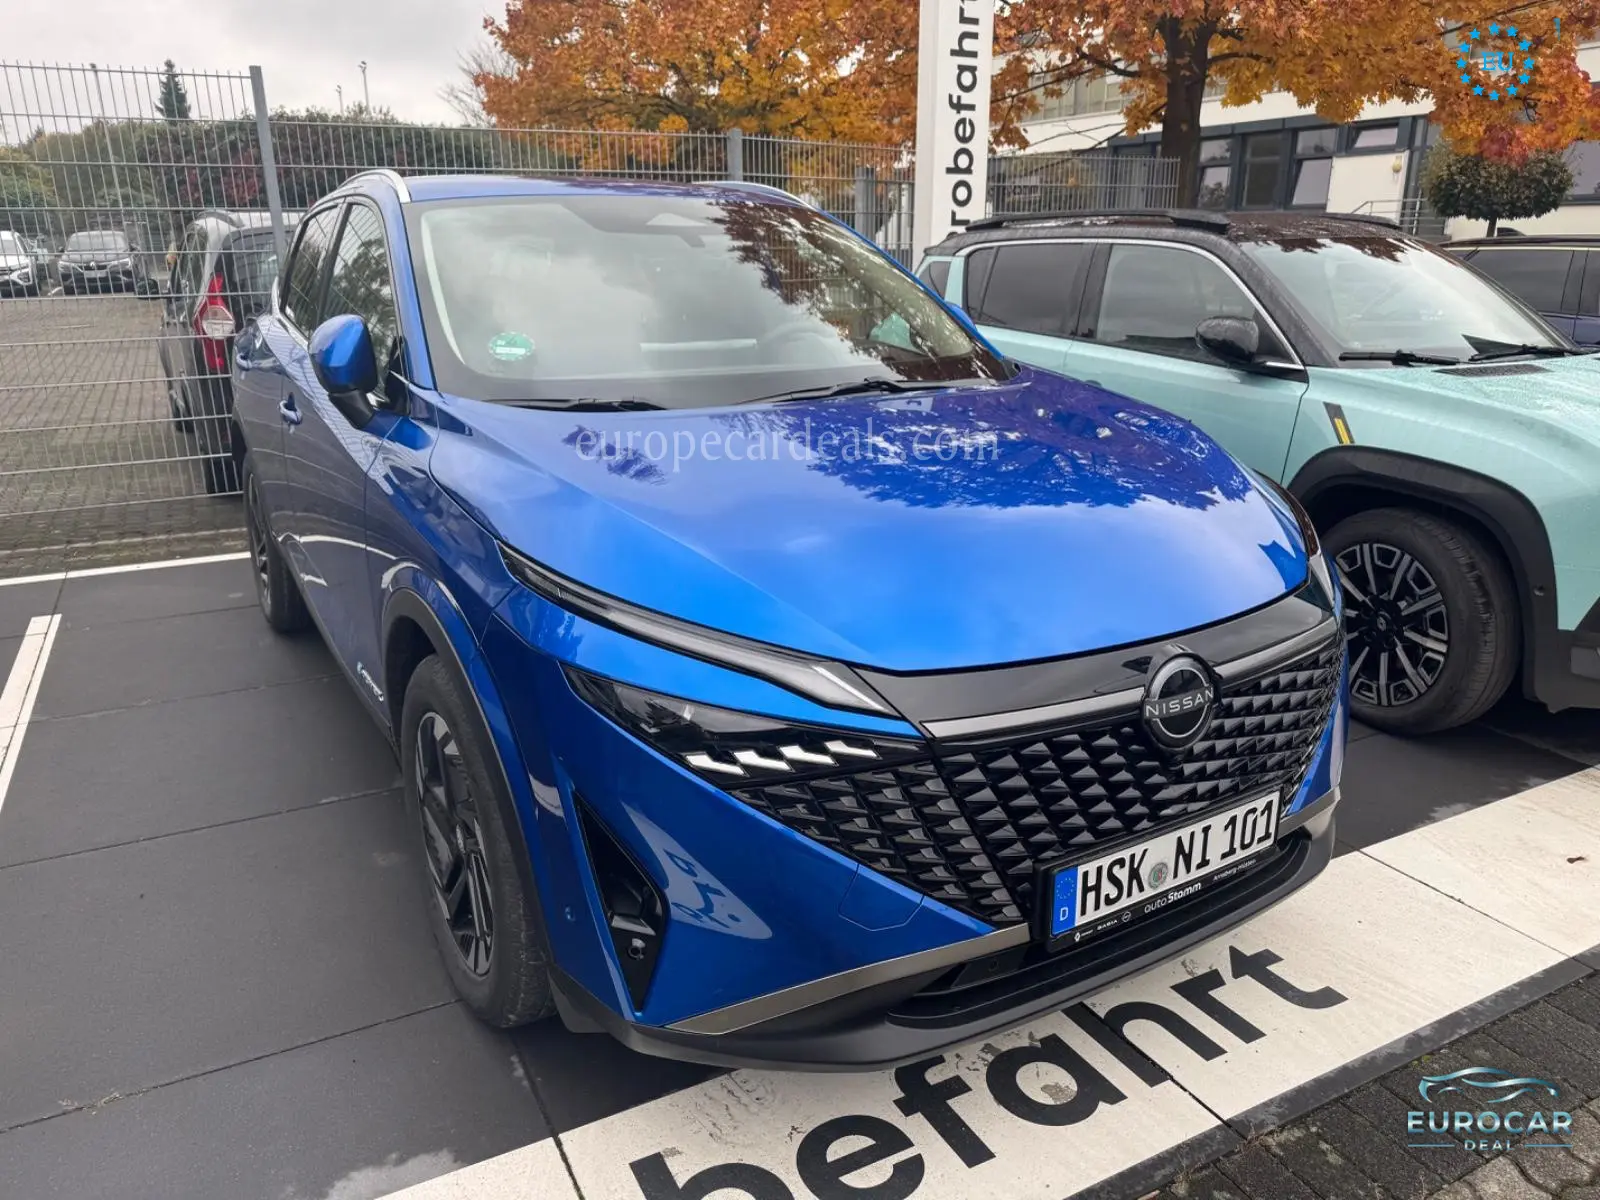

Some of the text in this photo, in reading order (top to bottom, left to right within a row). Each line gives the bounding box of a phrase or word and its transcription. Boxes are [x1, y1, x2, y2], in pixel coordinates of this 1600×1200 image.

[946, 0, 980, 238] robefahr
[1145, 687, 1214, 717] NISSAN
[1080, 799, 1274, 917] HSK NI 101
[1059, 906, 1069, 921] D
